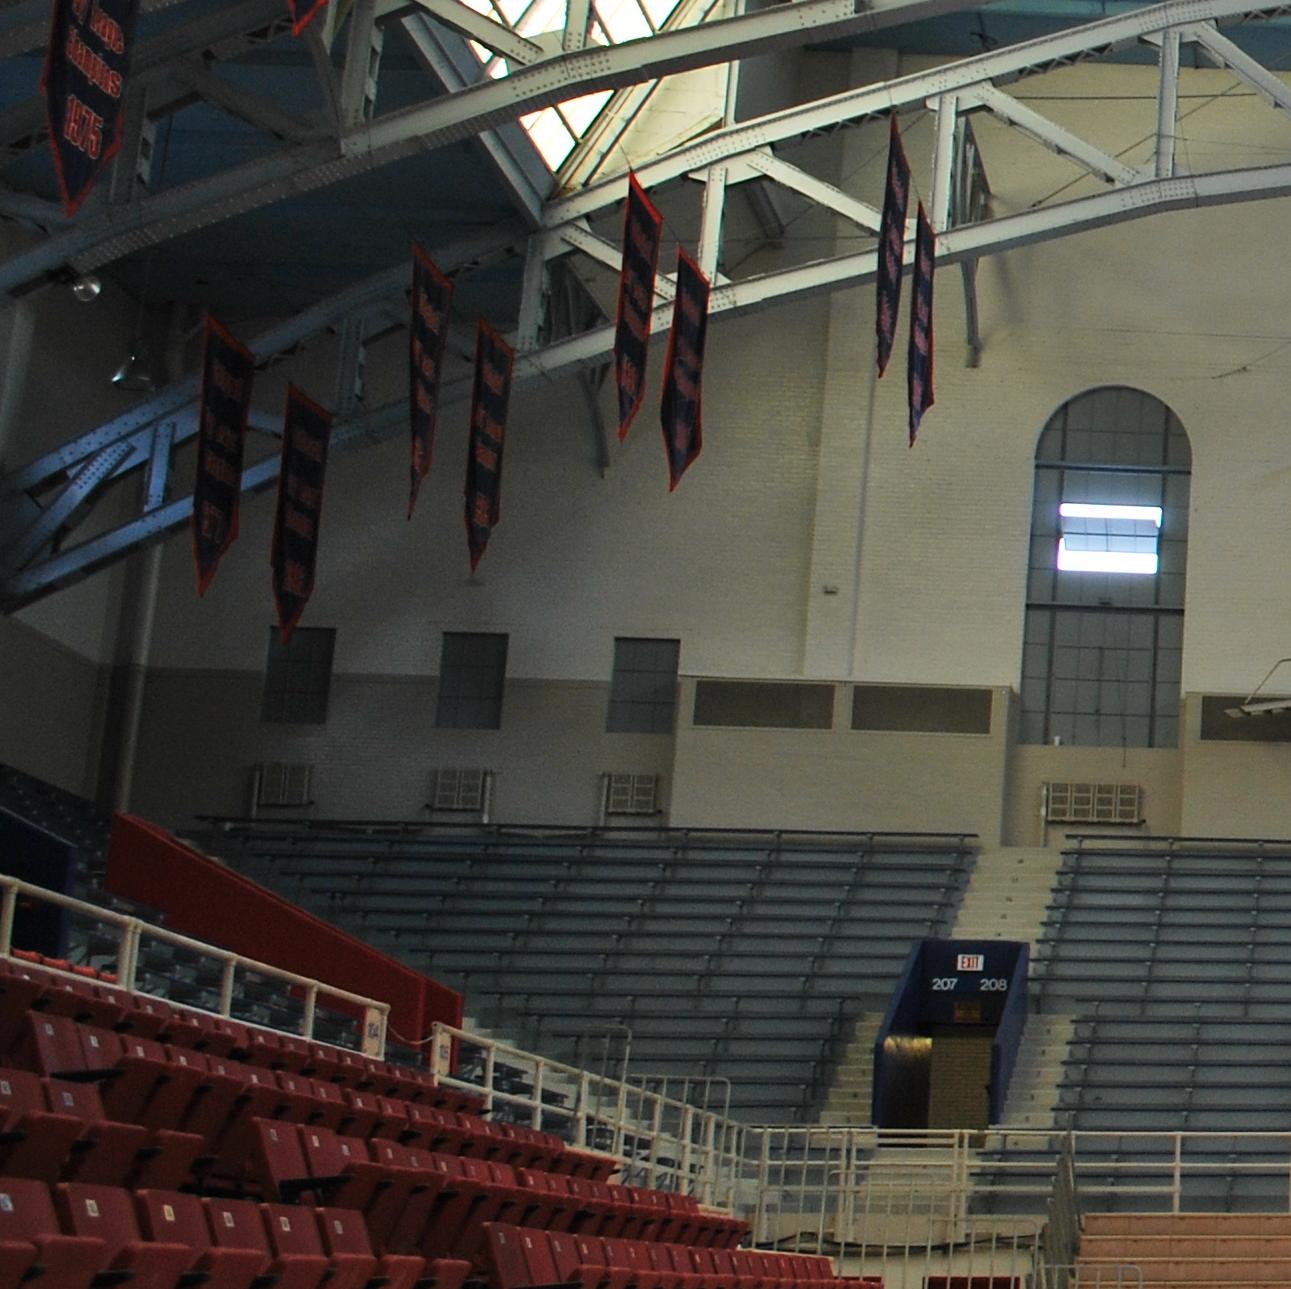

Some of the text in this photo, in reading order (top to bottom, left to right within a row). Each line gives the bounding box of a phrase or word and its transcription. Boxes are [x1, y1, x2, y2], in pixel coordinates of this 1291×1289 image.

[961, 955, 979, 969] EXIT
[932, 977, 1008, 991] 207 208
